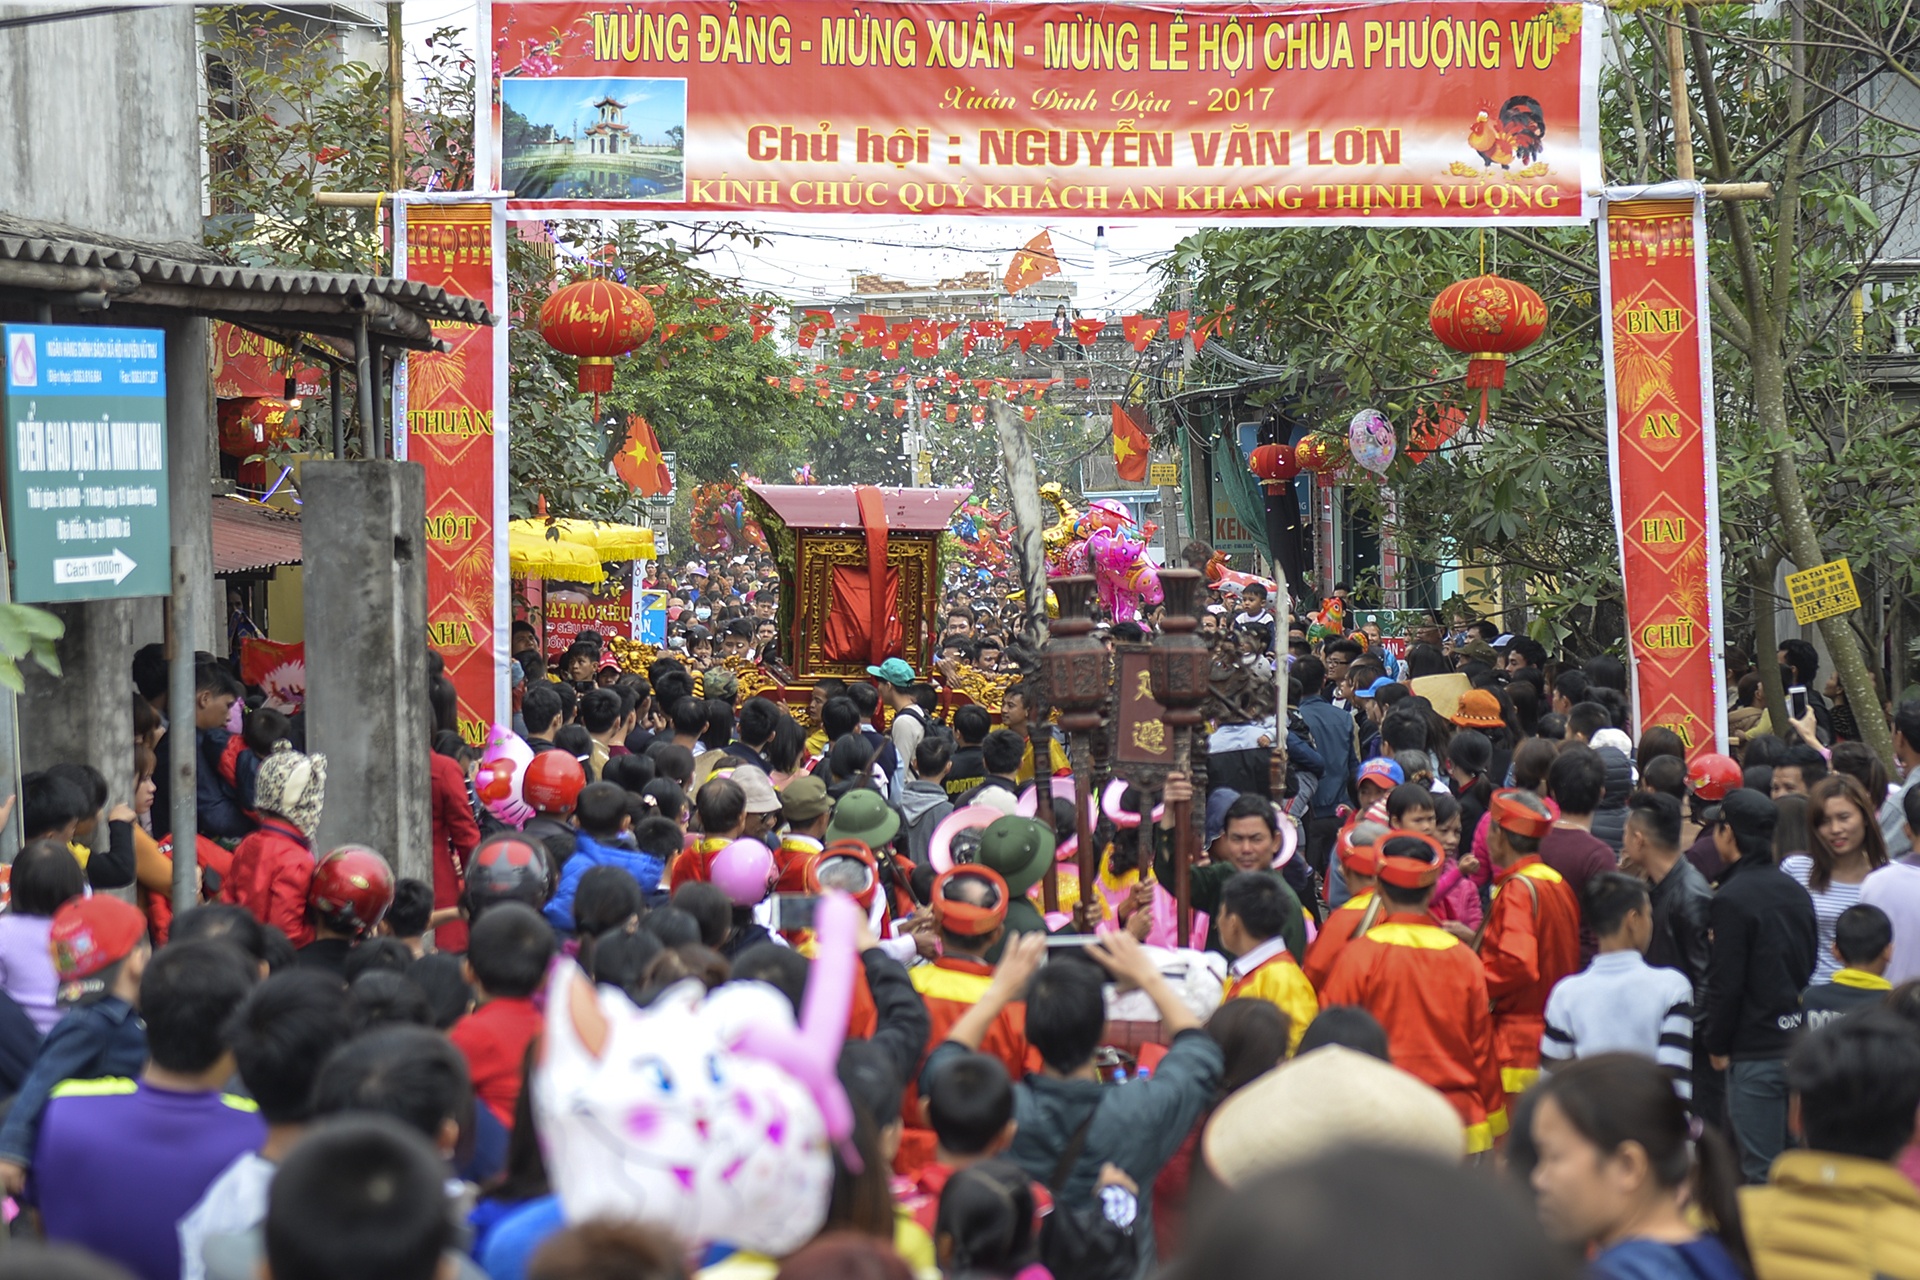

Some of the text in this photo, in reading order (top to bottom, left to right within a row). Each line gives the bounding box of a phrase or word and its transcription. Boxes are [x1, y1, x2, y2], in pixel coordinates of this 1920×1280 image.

[593, 5, 690, 63] MỪNG
[697, 0, 792, 66] ĐẢNG
[821, 9, 917, 68] MỪNG
[925, 12, 1015, 70] XUÂN
[1044, 12, 1139, 71] MỪNG
[1149, 8, 1189, 71] LỄ
[1198, 14, 1255, 78] HỘI
[1263, 13, 1355, 71] CHÙA
[1363, 14, 1501, 76] PHƯỢNG
[1510, 12, 1554, 70] VŨ
[938, 85, 1017, 111] Xuân
[1110, 88, 1171, 119] Dậu
[1207, 87, 1275, 112] 2017
[747, 120, 840, 163] Chủ
[856, 127, 931, 169] hội
[979, 119, 1174, 168] NGUYỄN
[1190, 123, 1291, 167] VĂN
[1307, 125, 1402, 166] LƠN
[691, 172, 1560, 215] KÍNH CHÚC QUÝ KHÁCH AN KHANG THỊNH VƯỢNG
[1626, 301, 1683, 334] BÌNH
[406, 406, 494, 438] THUẬN
[1640, 413, 1681, 440] AN
[425, 511, 476, 544] MỘT
[1641, 517, 1686, 544] HAI
[427, 613, 476, 648] NHÀ
[1642, 617, 1695, 649] CHỮ
